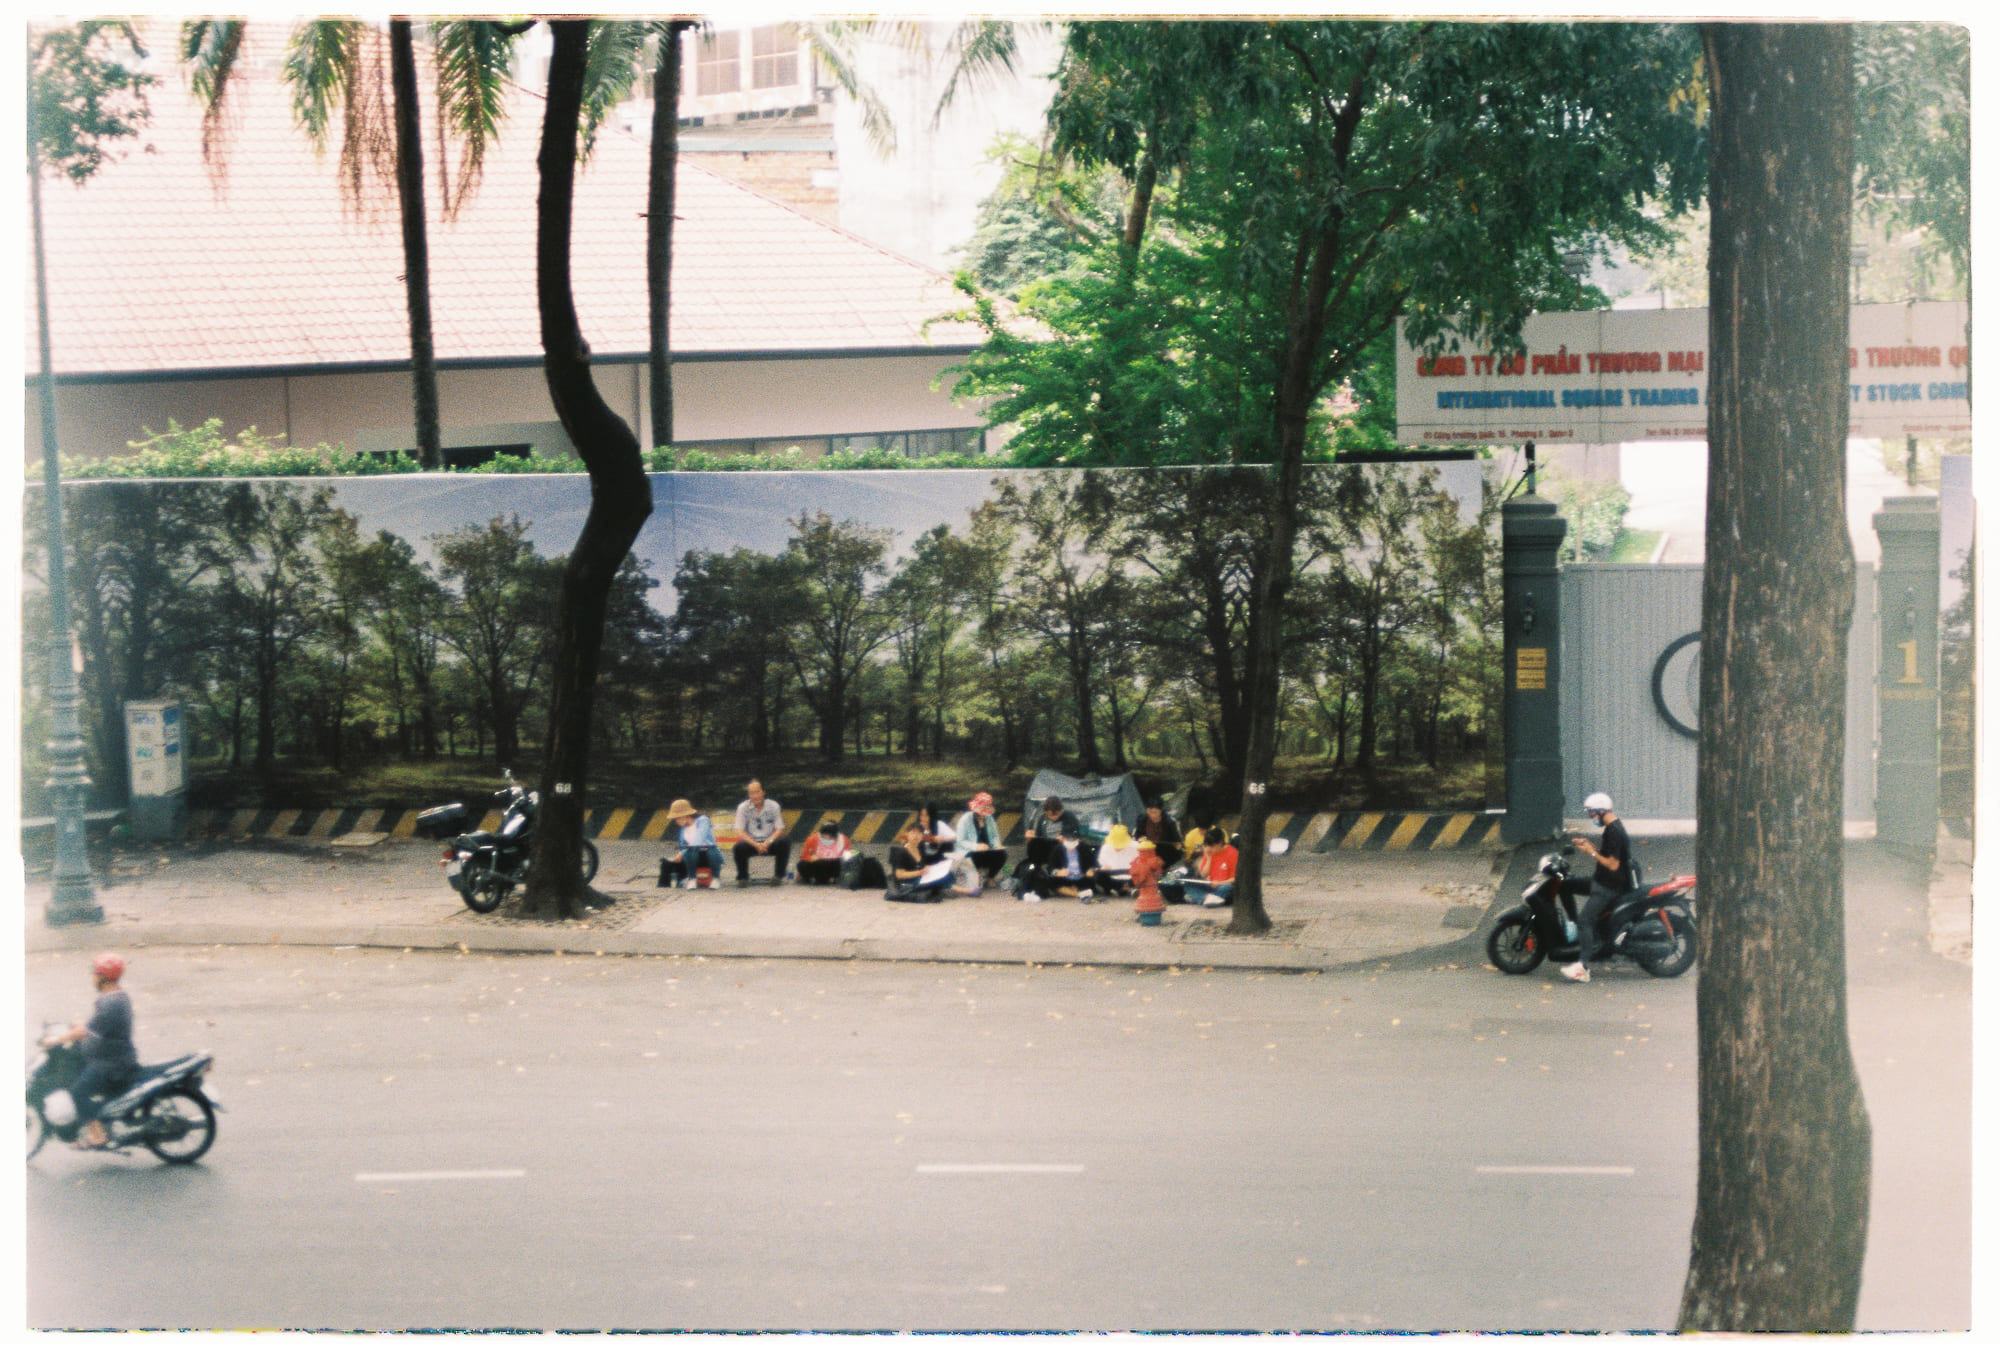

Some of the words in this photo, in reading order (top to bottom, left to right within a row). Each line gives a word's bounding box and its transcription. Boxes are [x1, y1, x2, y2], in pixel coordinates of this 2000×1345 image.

[1667, 350, 1704, 377] MẠI
[1437, 390, 1556, 409] INTERNATIONAL
[1561, 388, 1623, 409] SQUARE
[1628, 387, 1699, 407] TRADING
[1867, 383, 1922, 402] STOCK
[1896, 640, 1924, 684] 1
